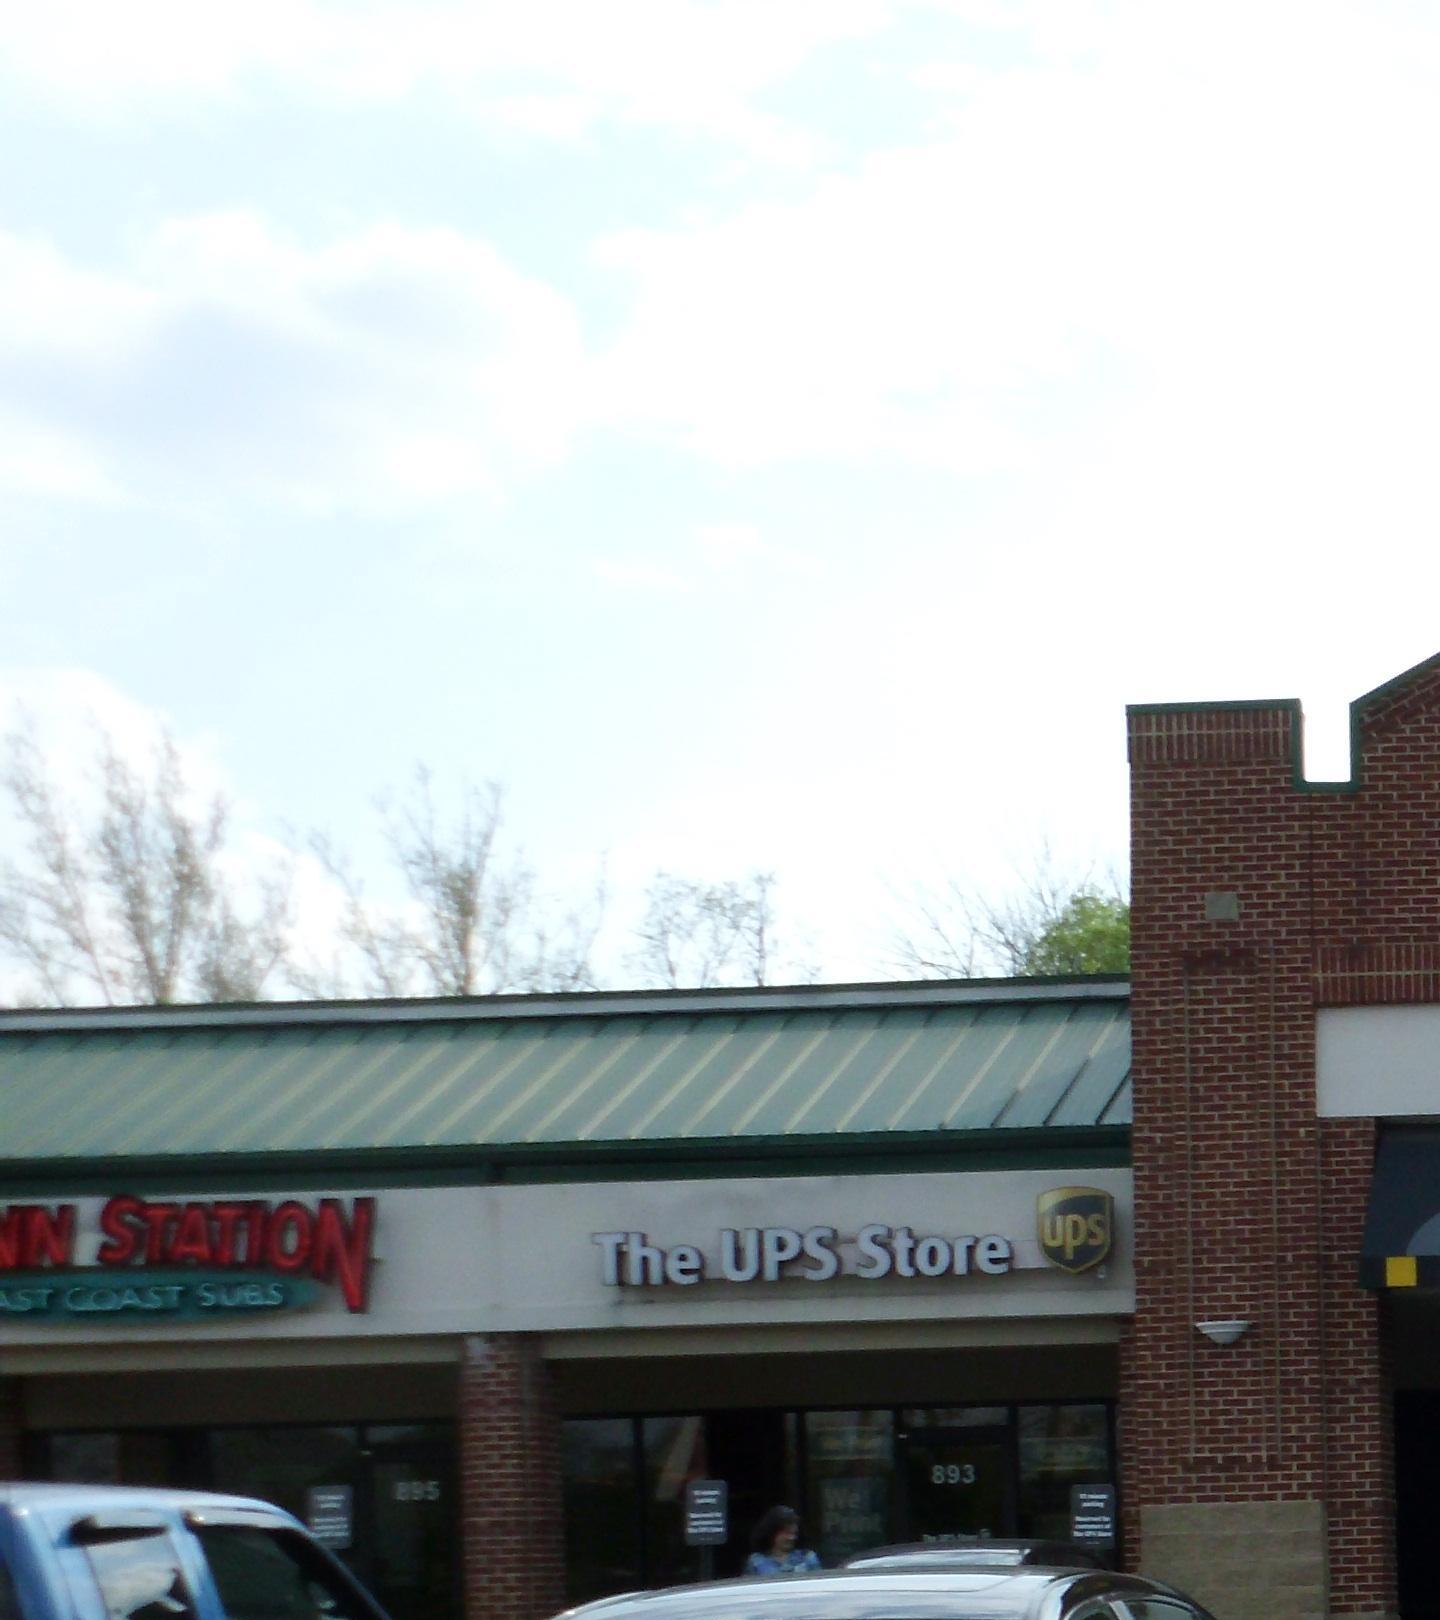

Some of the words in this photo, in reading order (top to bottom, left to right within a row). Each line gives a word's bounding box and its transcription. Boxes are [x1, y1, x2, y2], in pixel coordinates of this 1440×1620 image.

[593, 1231, 705, 1287] The
[720, 1225, 838, 1282] UPS
[855, 1223, 1013, 1280] Store
[1043, 1214, 1106, 1260] ups
[64, 1286, 184, 1312] COAST
[199, 1283, 285, 1307] SUBS
[931, 1464, 976, 1485] 893
